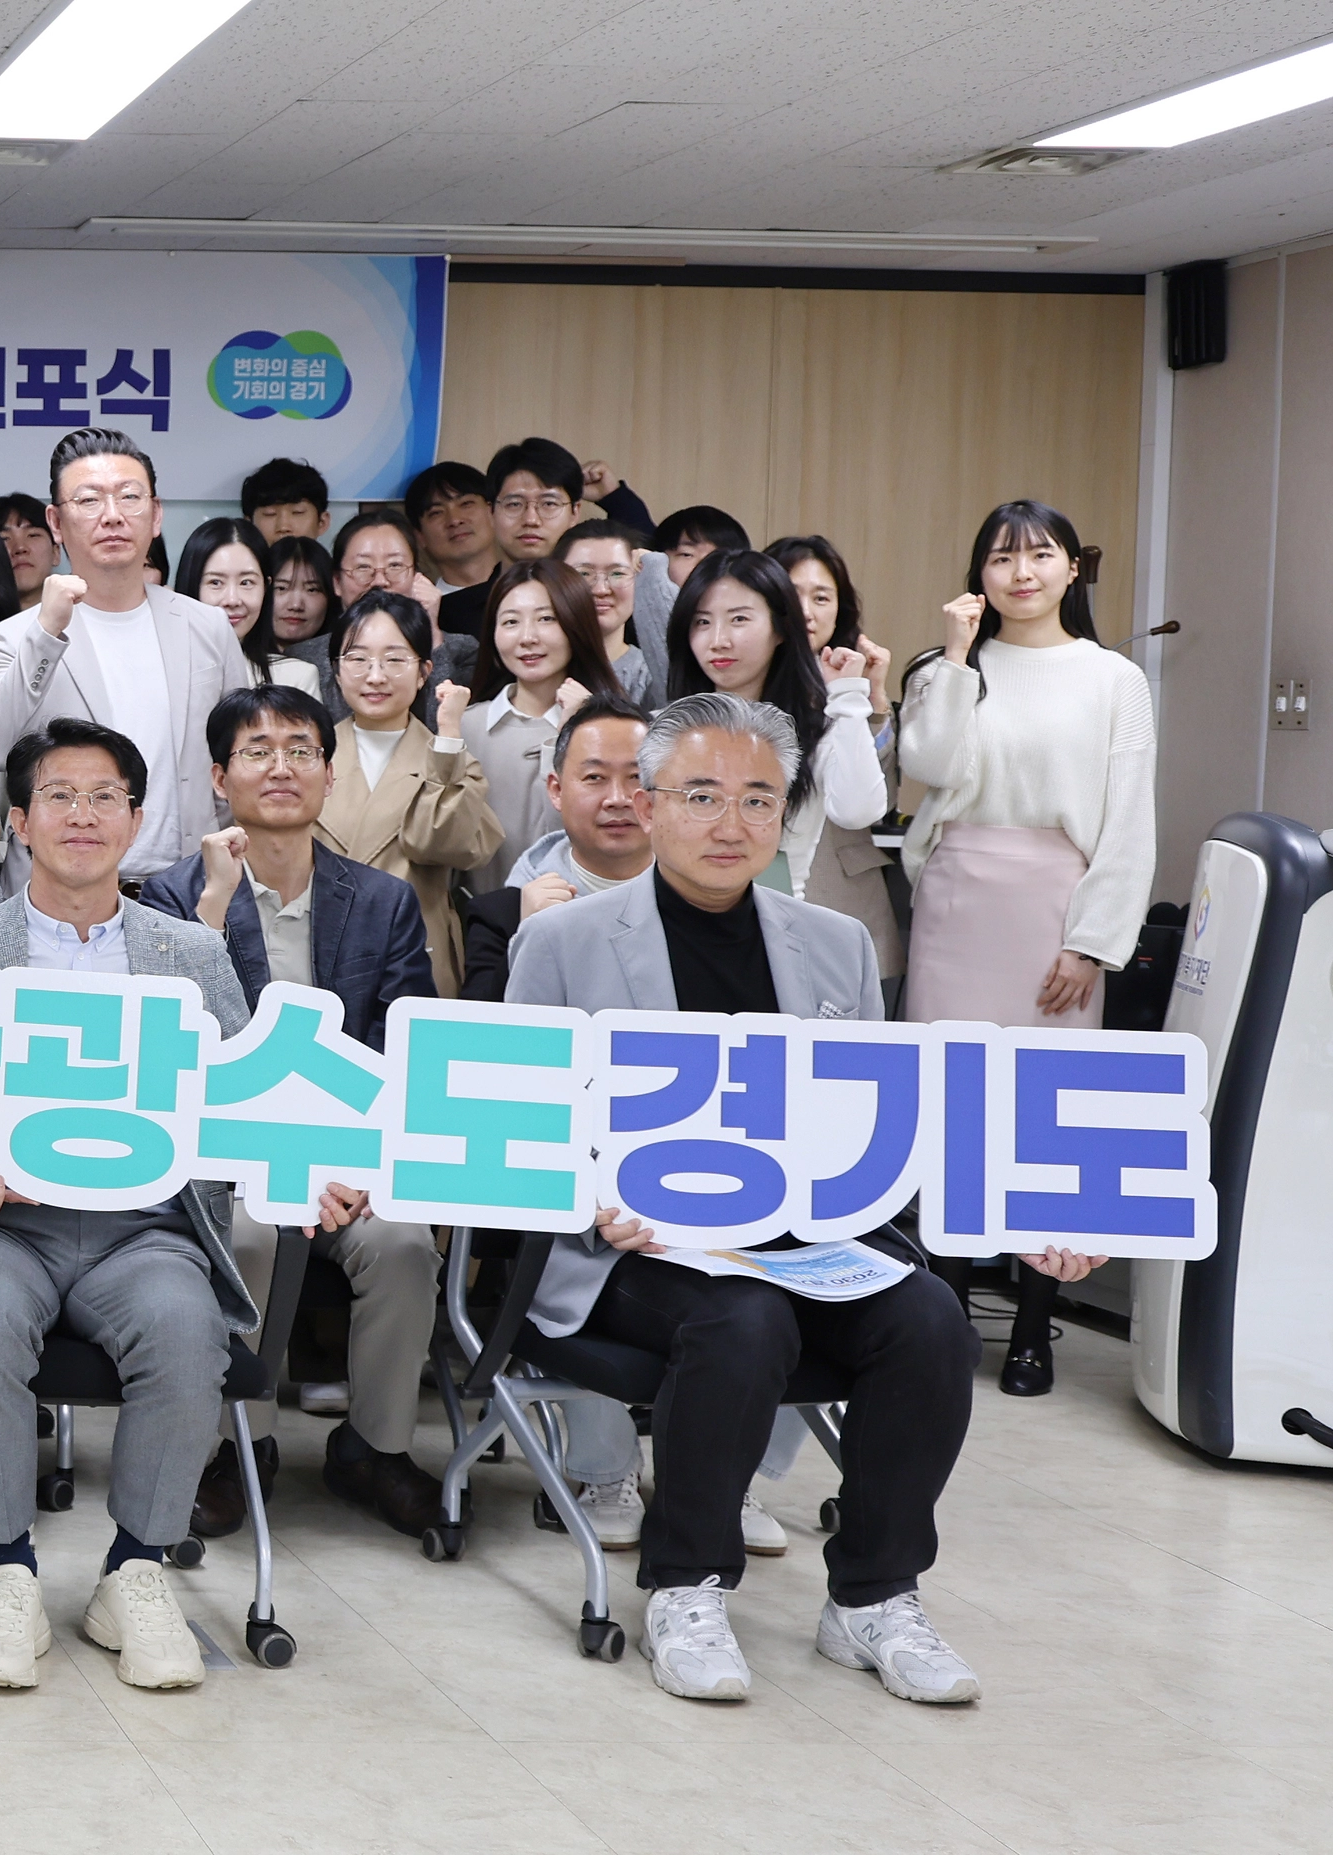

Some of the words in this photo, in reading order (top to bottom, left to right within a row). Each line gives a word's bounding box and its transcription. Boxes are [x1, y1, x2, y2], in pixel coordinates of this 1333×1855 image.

[233, 357, 288, 378] 변화의
[290, 358, 327, 378] 중심
[231, 380, 286, 400] 기회의
[289, 381, 326, 401] 경기
[608, 1028, 1196, 1239] 경기도
